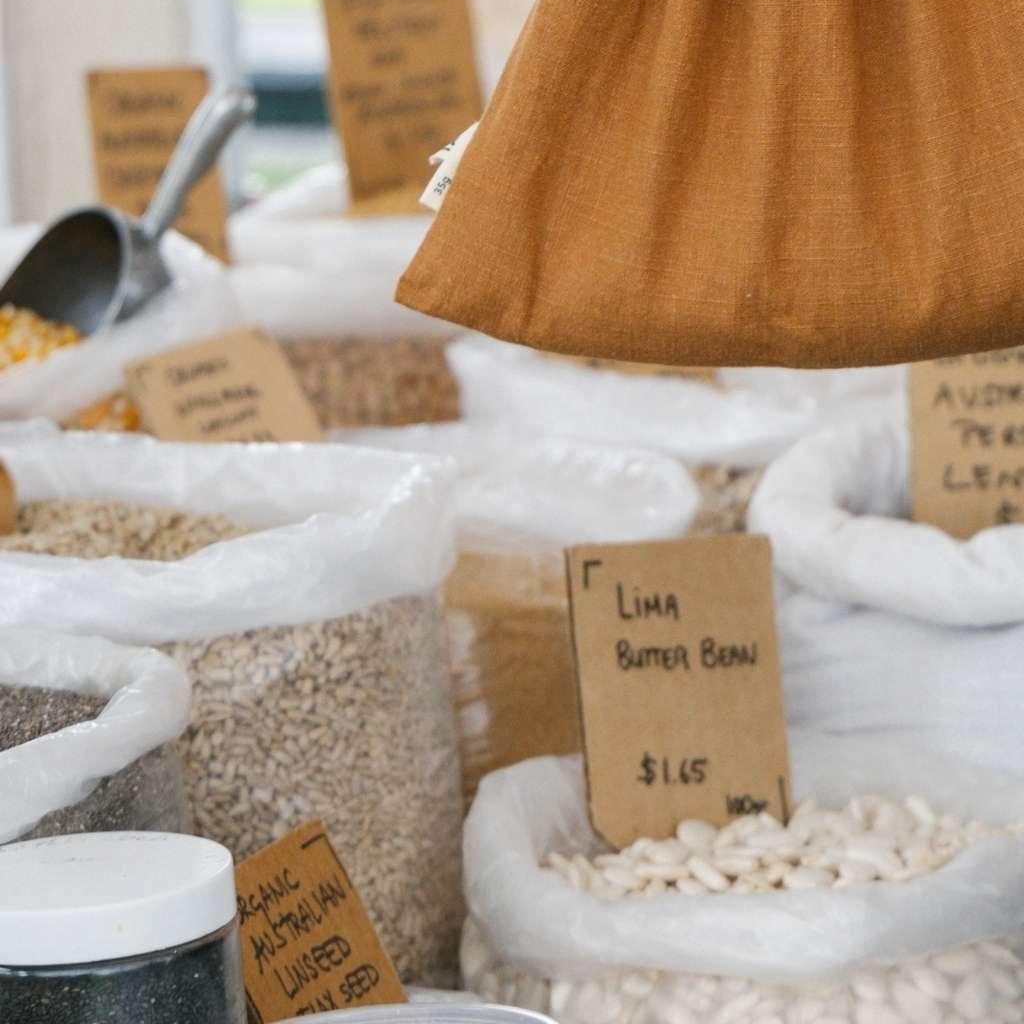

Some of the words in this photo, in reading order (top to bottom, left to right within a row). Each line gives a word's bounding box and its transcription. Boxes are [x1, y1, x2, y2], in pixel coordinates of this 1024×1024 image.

[433, 176, 452, 196] 35g
[615, 638, 690, 671] BUTTER
[700, 637, 758, 670] BEAN
[636, 751, 709, 786] $1.65
[237, 868, 300, 927] RGANIC
[250, 875, 346, 974] AUSTRALIAN
[274, 935, 352, 1000] LINSEED
